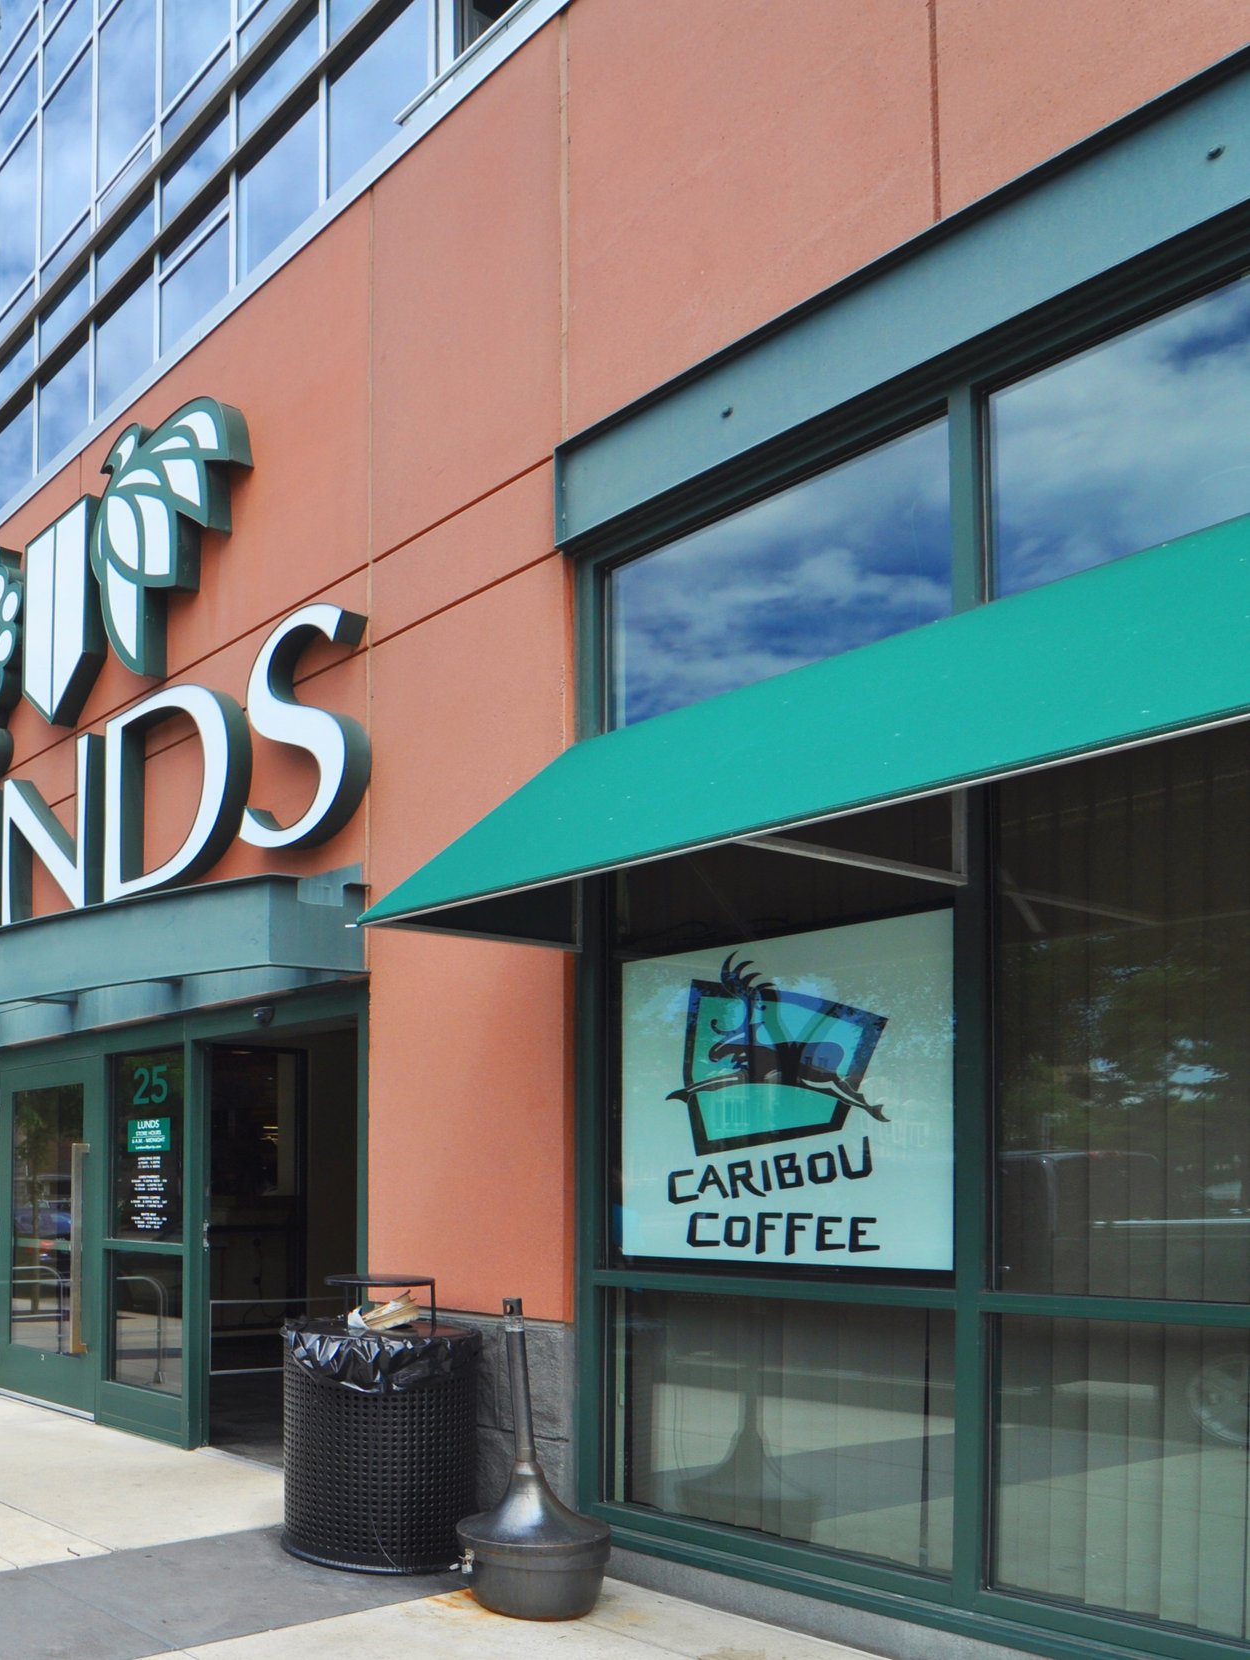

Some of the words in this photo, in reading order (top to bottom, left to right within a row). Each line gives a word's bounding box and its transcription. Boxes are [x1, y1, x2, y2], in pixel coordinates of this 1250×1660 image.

[133, 1064, 169, 1105] 25
[137, 1119, 160, 1129] LUNDS
[668, 1136, 873, 1204] CARIBOU
[687, 1212, 880, 1256] COFFEE
